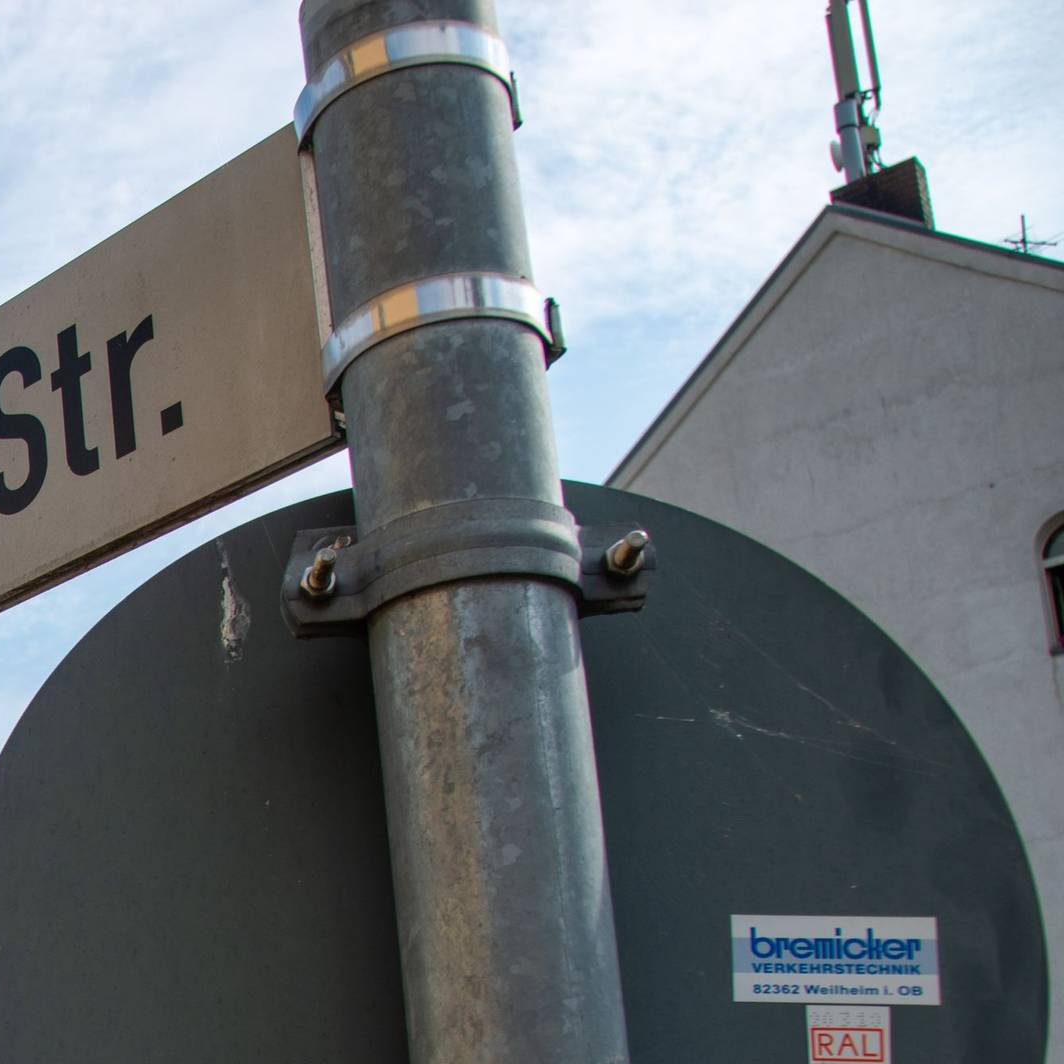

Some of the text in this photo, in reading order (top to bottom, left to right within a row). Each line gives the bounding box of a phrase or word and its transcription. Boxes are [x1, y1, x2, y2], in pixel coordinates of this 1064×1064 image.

[750, 927, 921, 960] bremicker
[752, 963, 921, 975] VERKEHRSTECHNIK
[753, 984, 800, 994] 82362
[804, 985, 879, 996] Weilheim
[898, 986, 923, 996] OB
[818, 1033, 878, 1056] RAL
